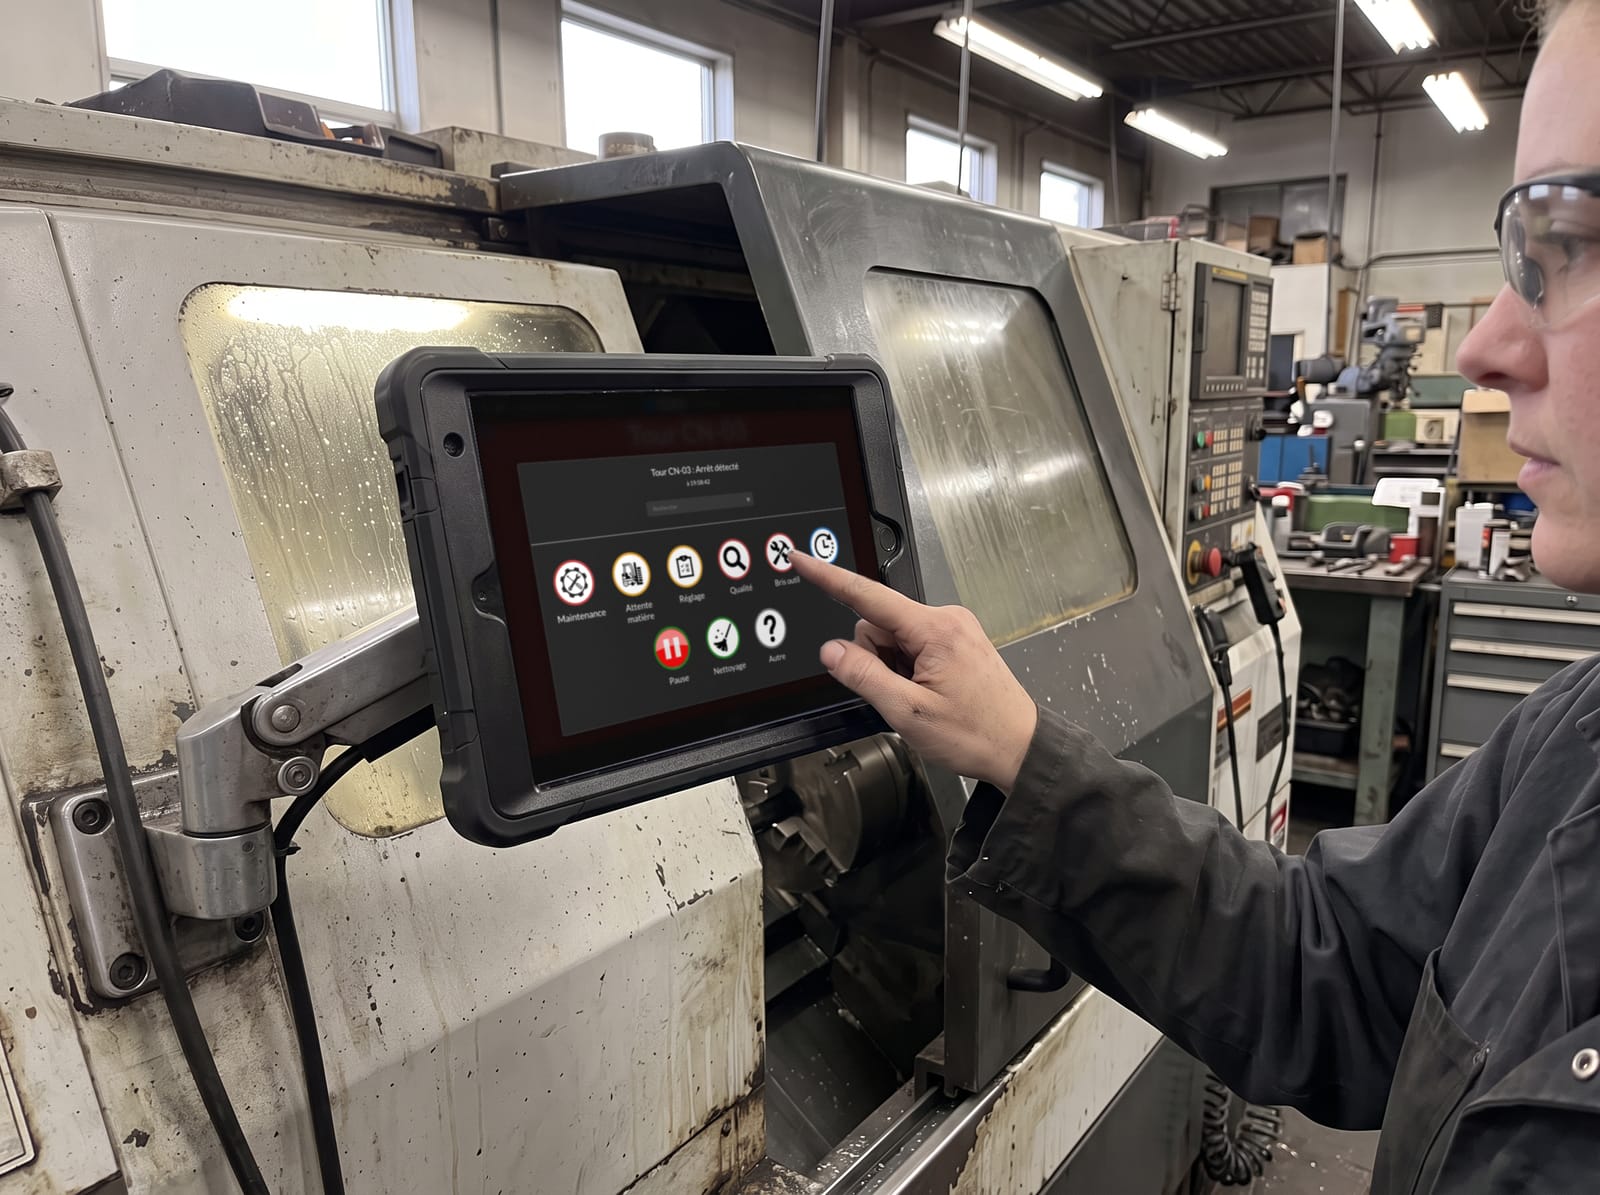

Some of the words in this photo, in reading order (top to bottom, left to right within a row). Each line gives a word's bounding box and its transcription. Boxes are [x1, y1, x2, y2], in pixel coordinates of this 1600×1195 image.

[650, 468, 667, 477] Tour
[668, 465, 692, 476] CN-03
[714, 462, 739, 472] détecté
[774, 578, 787, 587] Bris
[787, 576, 800, 585] outil
[729, 584, 753, 595] Qualité
[679, 593, 705, 603] Réglage
[625, 602, 653, 612] Attente
[557, 609, 607, 624] Maintenance
[627, 613, 655, 624] matière
[768, 654, 786, 663] Autre
[713, 663, 747, 676] Nettoyage
[669, 675, 690, 685] Pause
